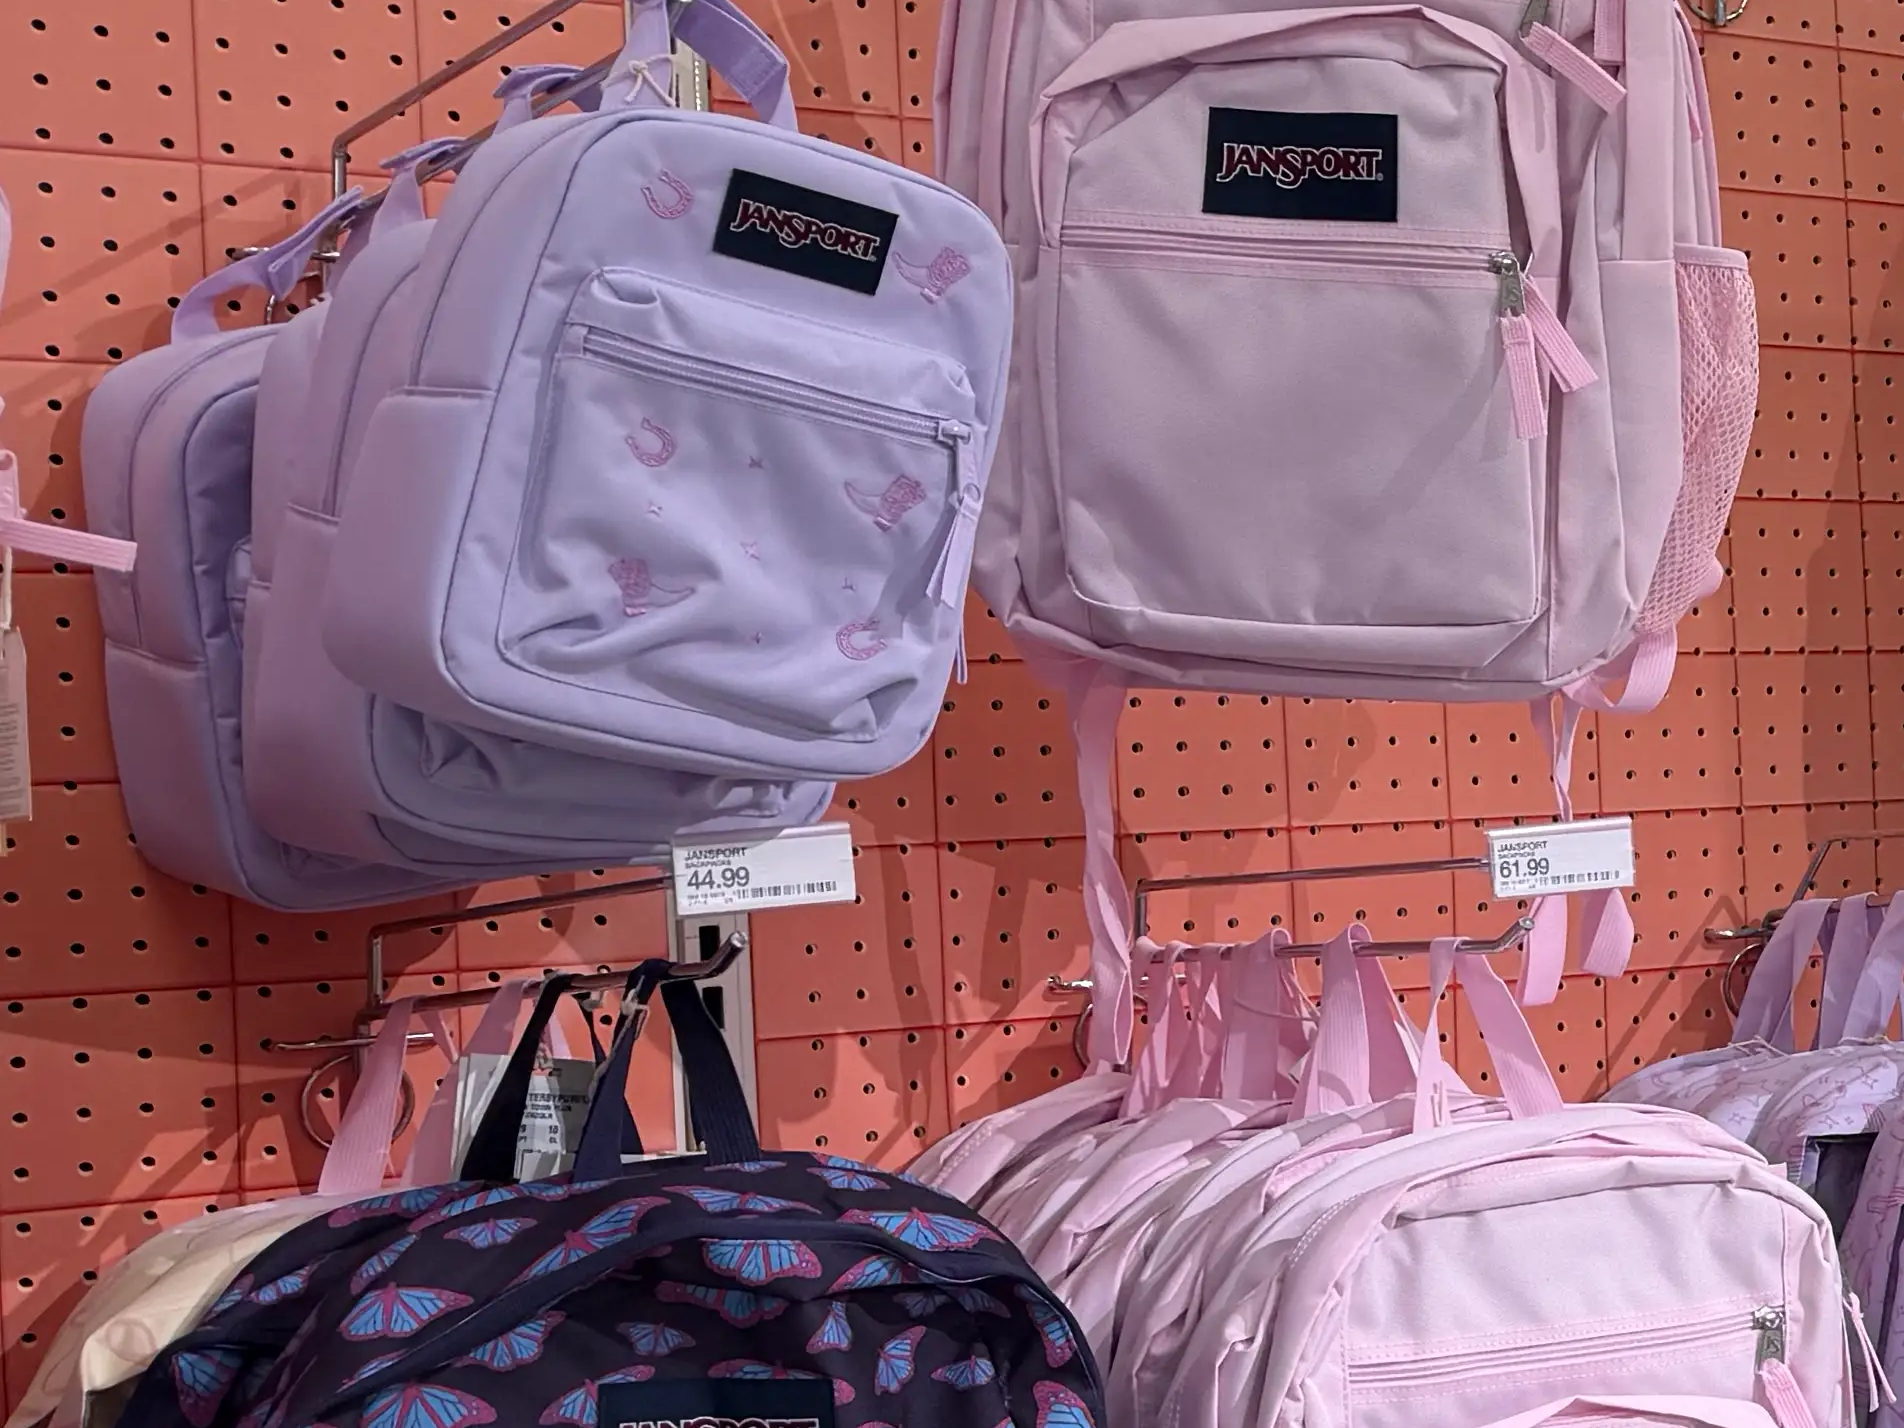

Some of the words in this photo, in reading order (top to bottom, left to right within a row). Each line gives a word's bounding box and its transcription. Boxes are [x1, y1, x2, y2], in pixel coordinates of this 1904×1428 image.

[1215, 142, 1384, 189] JANSPORT
[729, 198, 881, 261] JANSPORT
[685, 846, 748, 861] JANSPORT
[1497, 840, 1549, 853] JANSPORT
[687, 866, 750, 890] 44.99
[1499, 857, 1550, 879] 61.99
